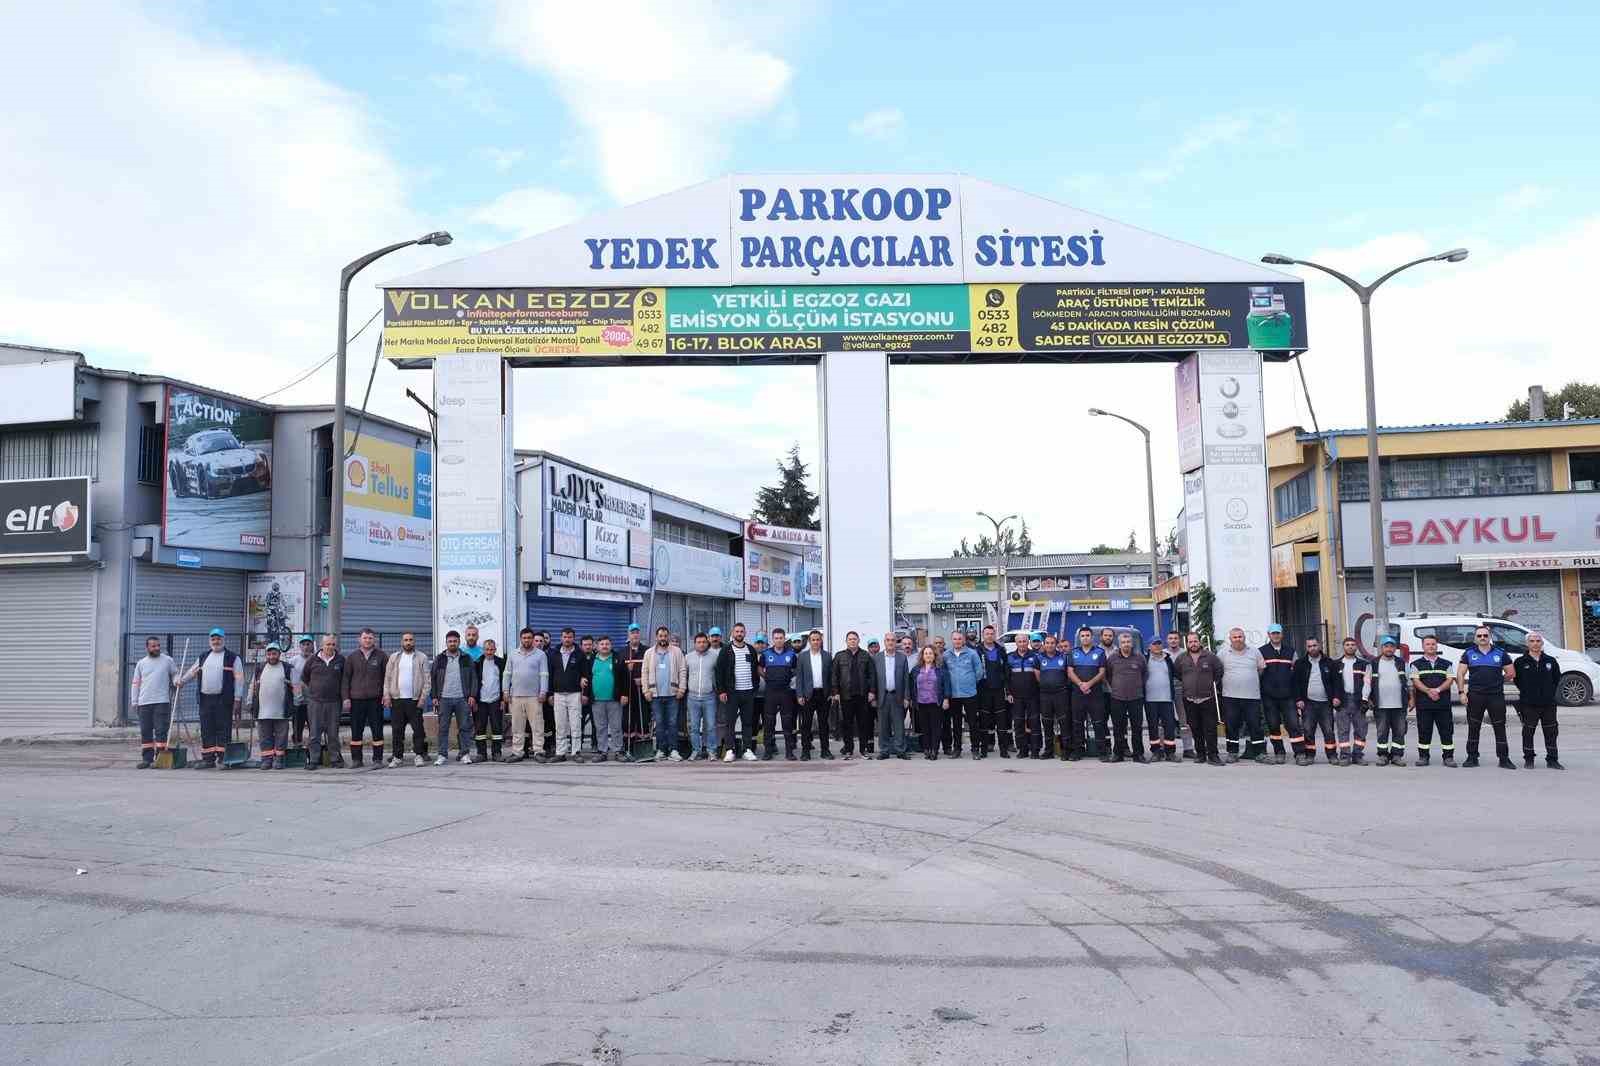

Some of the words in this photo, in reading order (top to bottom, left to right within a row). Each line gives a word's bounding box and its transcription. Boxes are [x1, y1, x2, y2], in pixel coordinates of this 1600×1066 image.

[739, 188, 951, 221] PARKOOP
[584, 238, 719, 269] YEDEK
[740, 235, 954, 275] PARÇACILAR
[975, 228, 1106, 266] SİTESİ
[387, 291, 515, 316] VOLKAN
[527, 293, 631, 308] EGZOZ
[713, 289, 786, 308] YETKİLİ
[793, 293, 860, 307] EGZOZ
[864, 292, 911, 307] GAZI
[1057, 299, 1090, 310] ARAÇ
[1093, 296, 1149, 307] ÜSTÜNDE
[1152, 295, 1206, 307] TEMİZLİK
[638, 310, 662, 319] 0533
[669, 309, 760, 328] EMİSYON
[766, 309, 838, 330] ÖLÇÜM
[844, 308, 955, 327] İSTASYONU
[978, 310, 1010, 320] 0533
[526, 326, 576, 334] KAMPANYA
[641, 324, 660, 333] 482
[981, 323, 1008, 333] 482
[1050, 322, 1065, 331] 45
[1067, 319, 1131, 330] DAKİKADA
[1134, 319, 1168, 330] KESİN
[1171, 318, 1215, 332] ÇÖZÜM
[669, 337, 713, 350] 16-17.
[717, 337, 766, 350] BLOK
[769, 337, 822, 349] ARASI
[842, 333, 955, 342] www.volkanegzoz.com.tr
[976, 337, 993, 347] 49
[997, 337, 1014, 347] 67
[1035, 335, 1090, 346] SADECE
[1097, 335, 1154, 345] VOLKAN
[636, 339, 650, 349] 49
[651, 339, 664, 349] 67
[371, 475, 409, 501] Tellus
[6, 505, 52, 532] elf
[1389, 515, 1558, 545] BAYKUL
[241, 535, 265, 545] MOTUL
[1497, 560, 1562, 568] BAYKUL
